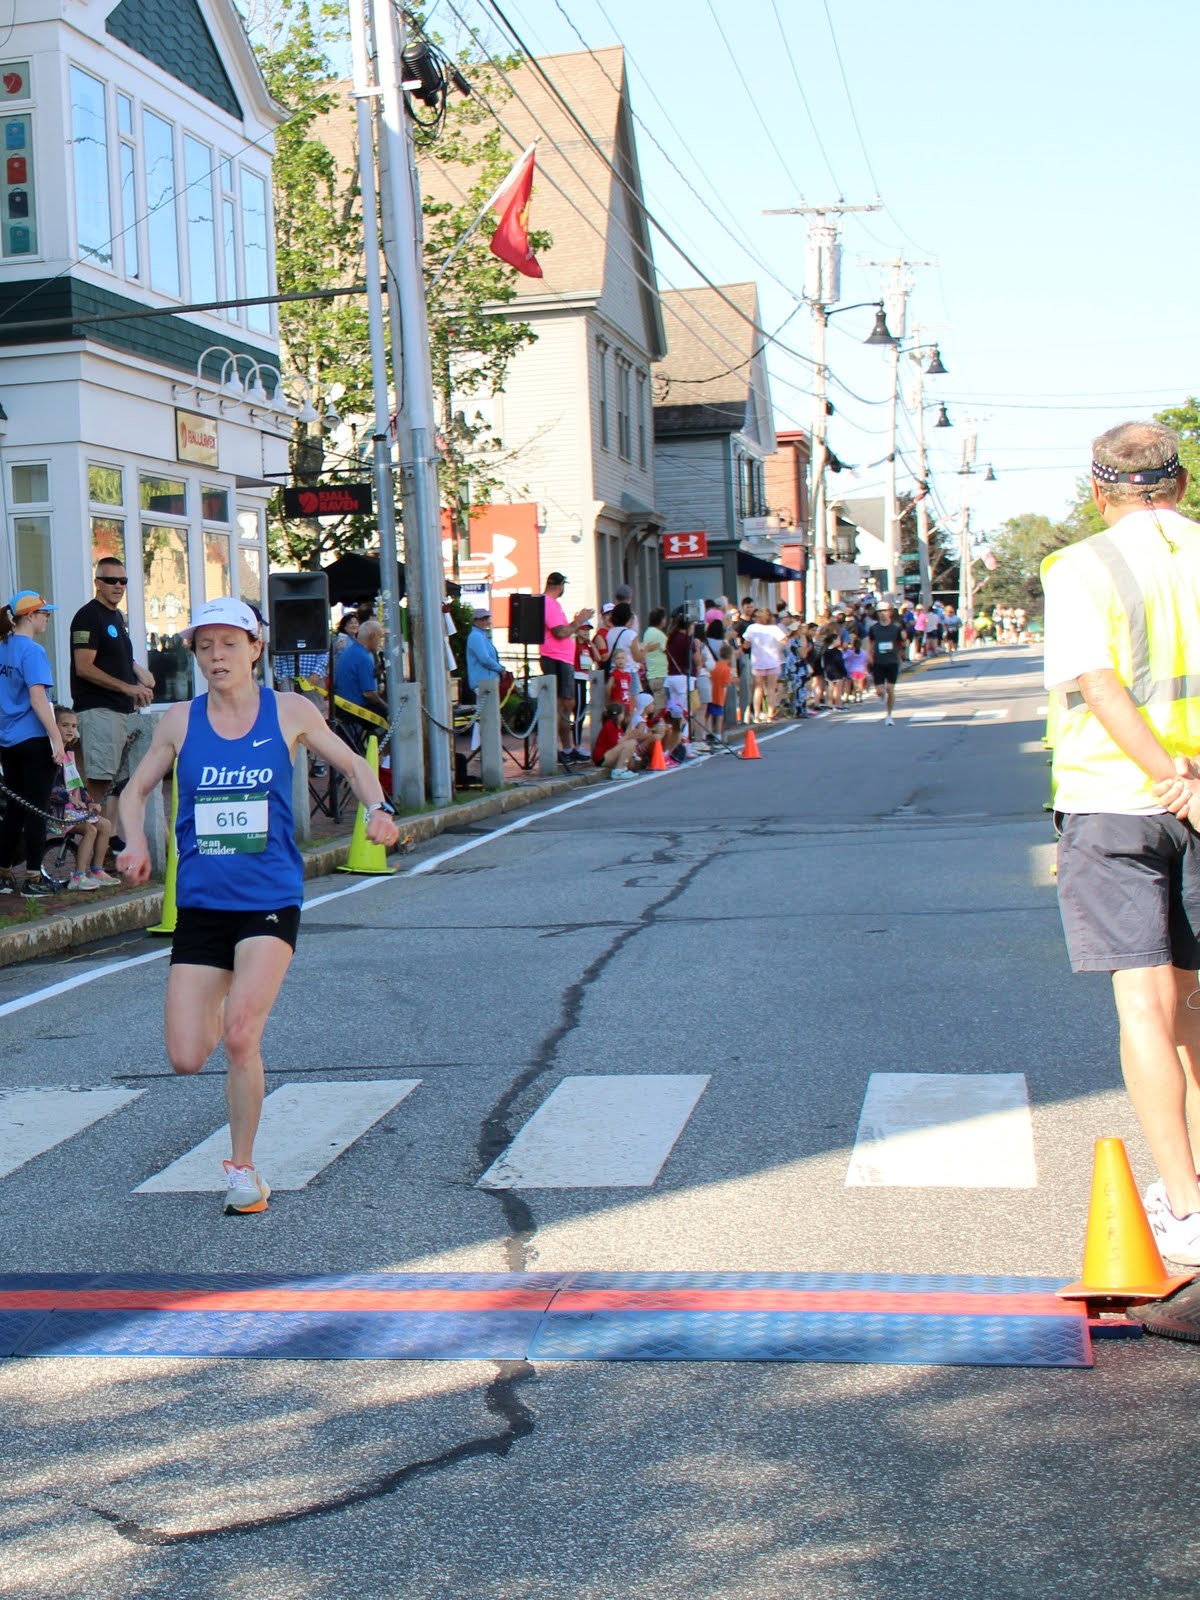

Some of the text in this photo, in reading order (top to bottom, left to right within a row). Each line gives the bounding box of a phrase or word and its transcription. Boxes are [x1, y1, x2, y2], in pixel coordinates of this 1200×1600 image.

[198, 766, 273, 789] Dirigo
[216, 811, 248, 828] 616
[197, 838, 221, 848] Bean
[198, 846, 237, 855] Outsider
